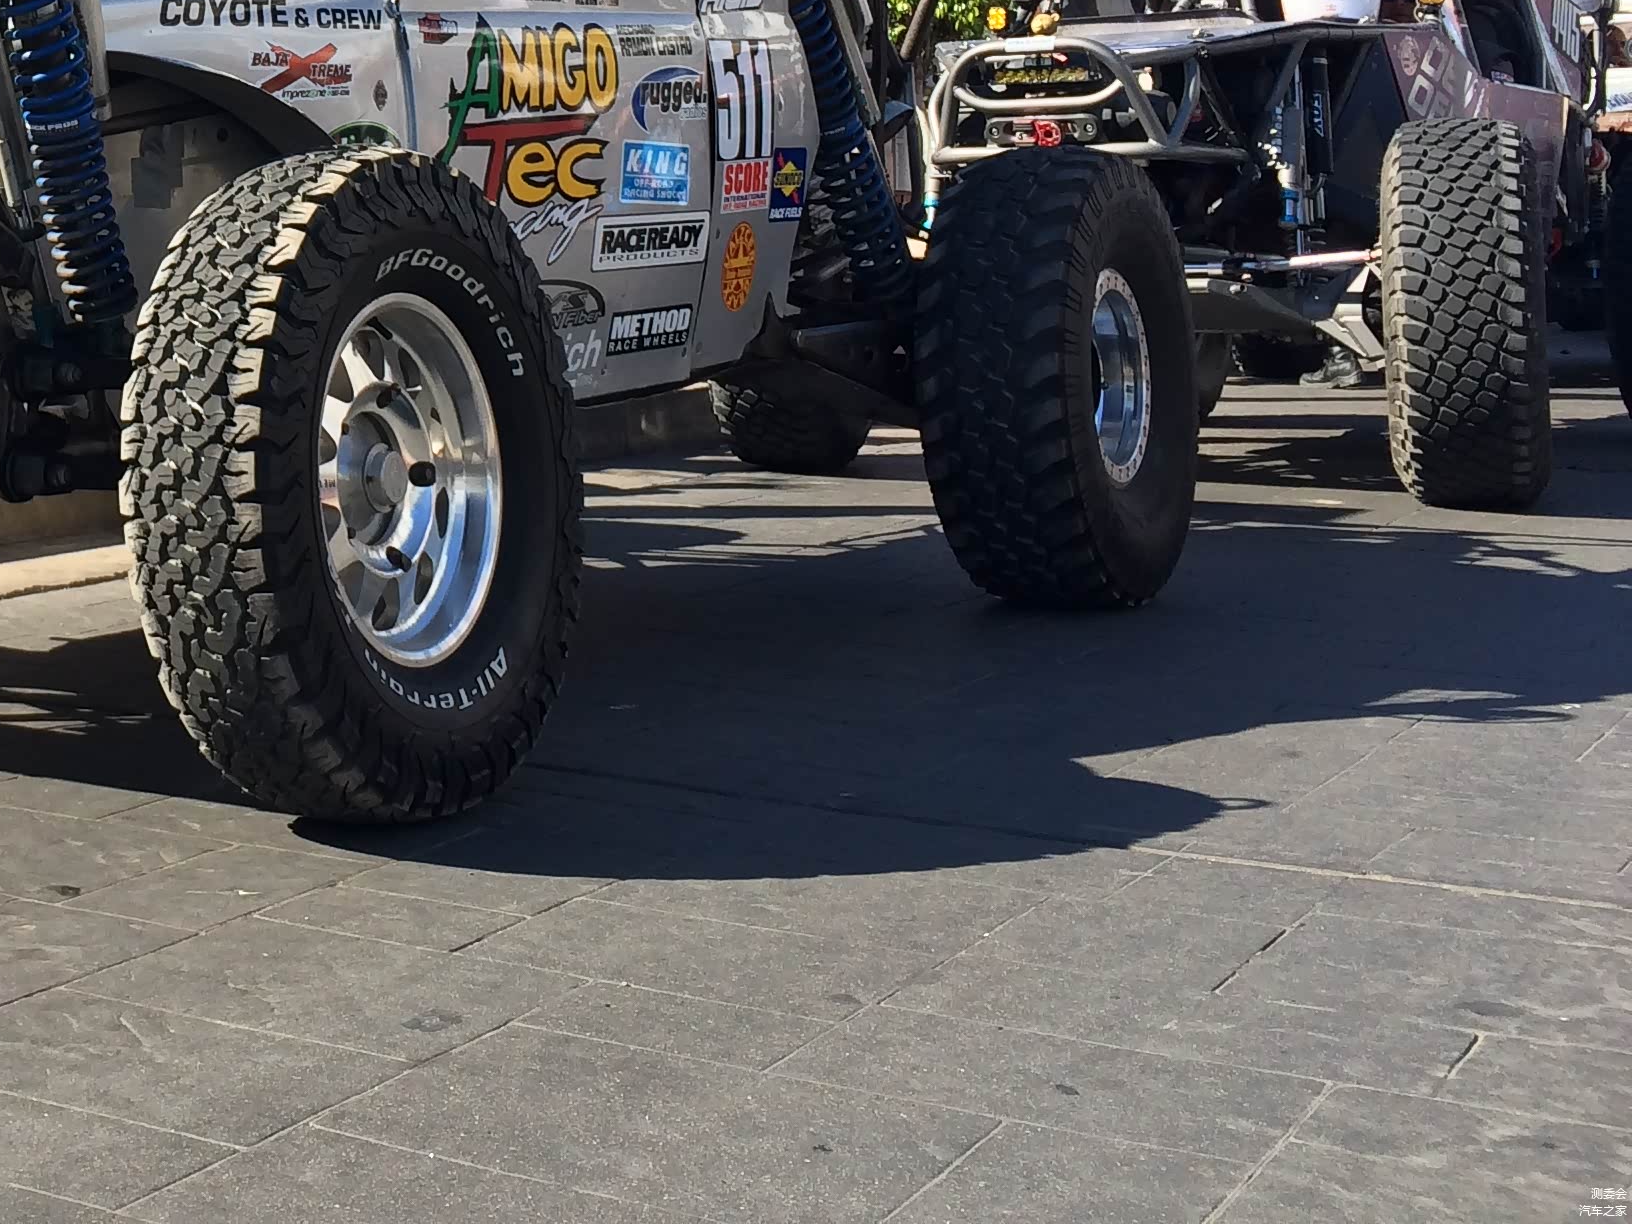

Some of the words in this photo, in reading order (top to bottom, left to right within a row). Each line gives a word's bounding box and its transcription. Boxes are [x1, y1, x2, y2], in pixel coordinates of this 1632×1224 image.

[294, 7, 310, 28] &
[316, 7, 382, 30] CREW
[250, 51, 290, 67] BAJA
[441, 12, 619, 166] AMIGO
[708, 39, 772, 160] 511
[457, 114, 610, 208] Tec
[626, 148, 688, 176] KING
[724, 160, 769, 196] SCORE
[599, 249, 700, 264] PRODUCTS
[374, 248, 524, 377] BFGoodrich
[610, 307, 692, 340] METHOD
[608, 338, 638, 353] RACE
[643, 332, 688, 348] WHEELS
